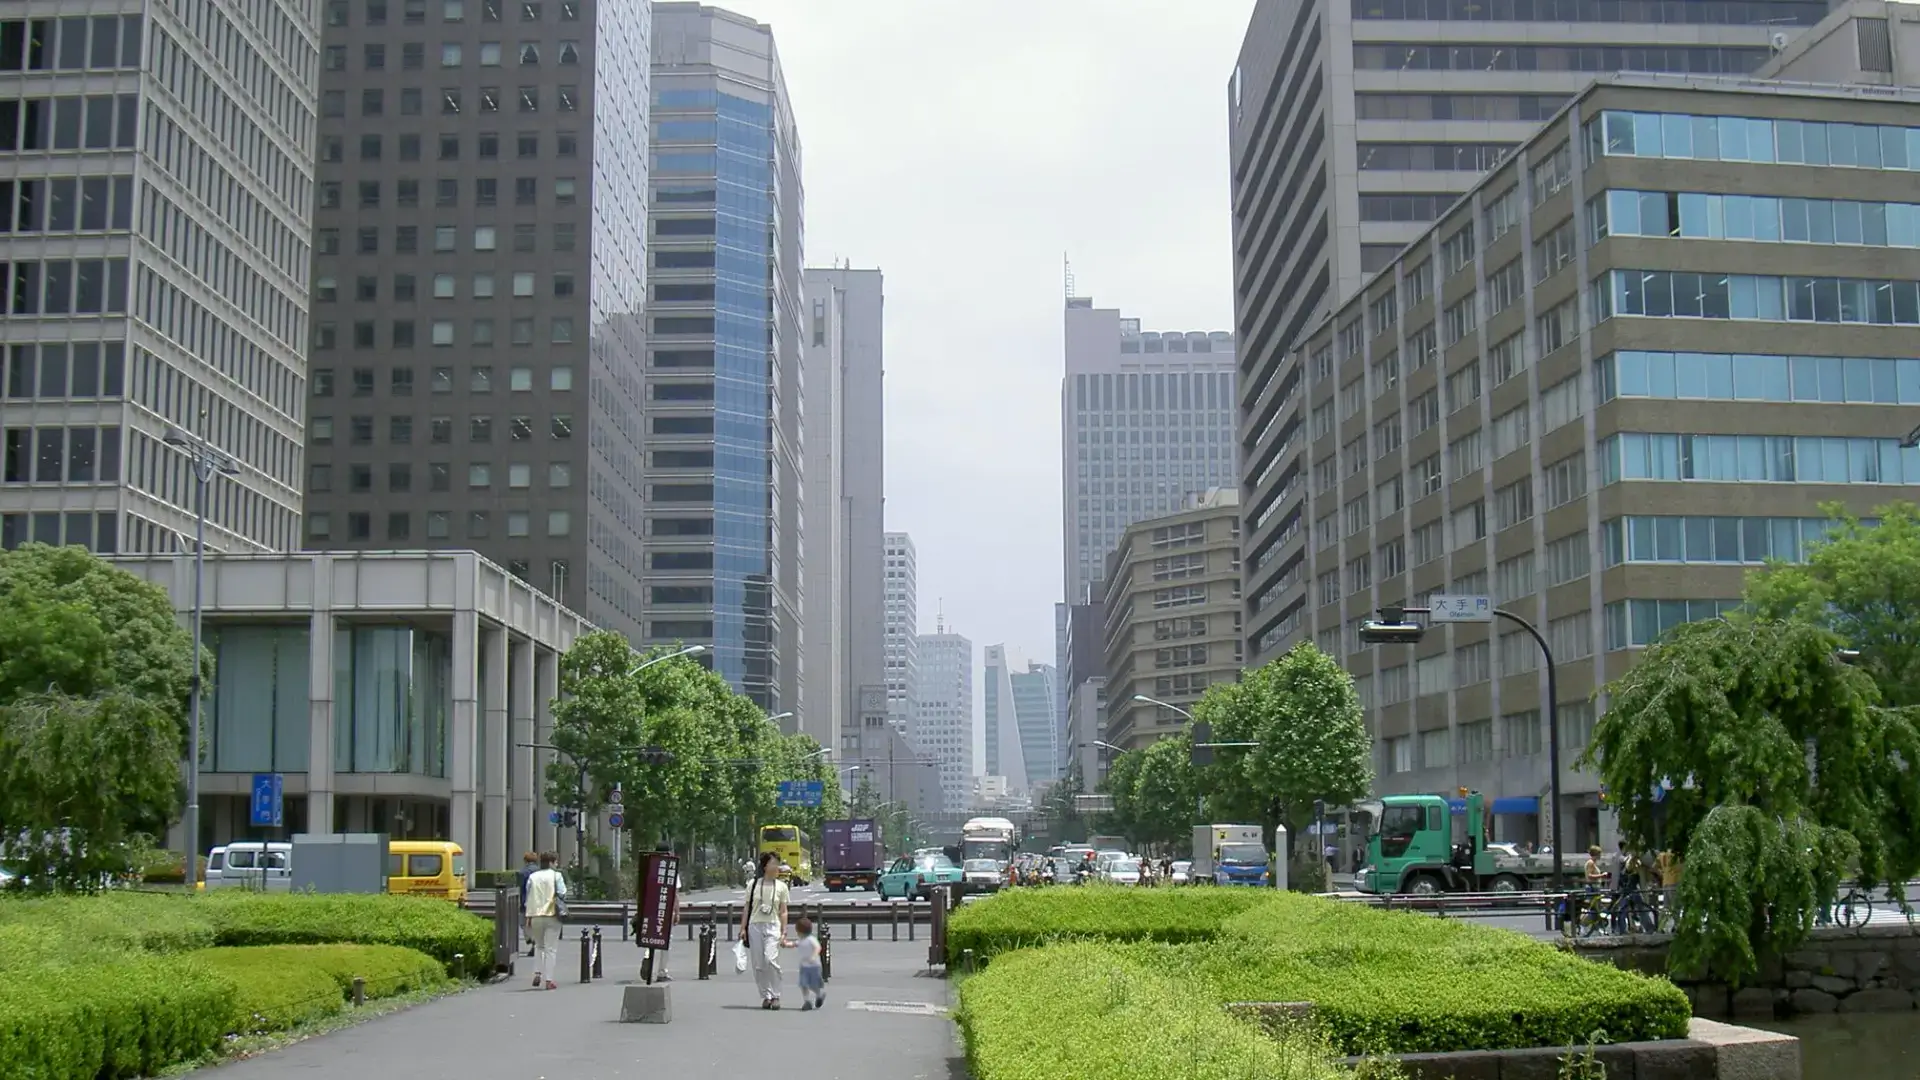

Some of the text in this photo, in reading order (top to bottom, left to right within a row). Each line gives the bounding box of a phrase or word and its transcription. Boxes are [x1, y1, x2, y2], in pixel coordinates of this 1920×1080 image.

[1435, 598, 1488, 611] 大手門
[657, 859, 667, 884] 金曜日
[667, 861, 677, 885] 月曜日
[641, 937, 665, 945] CLOSED
